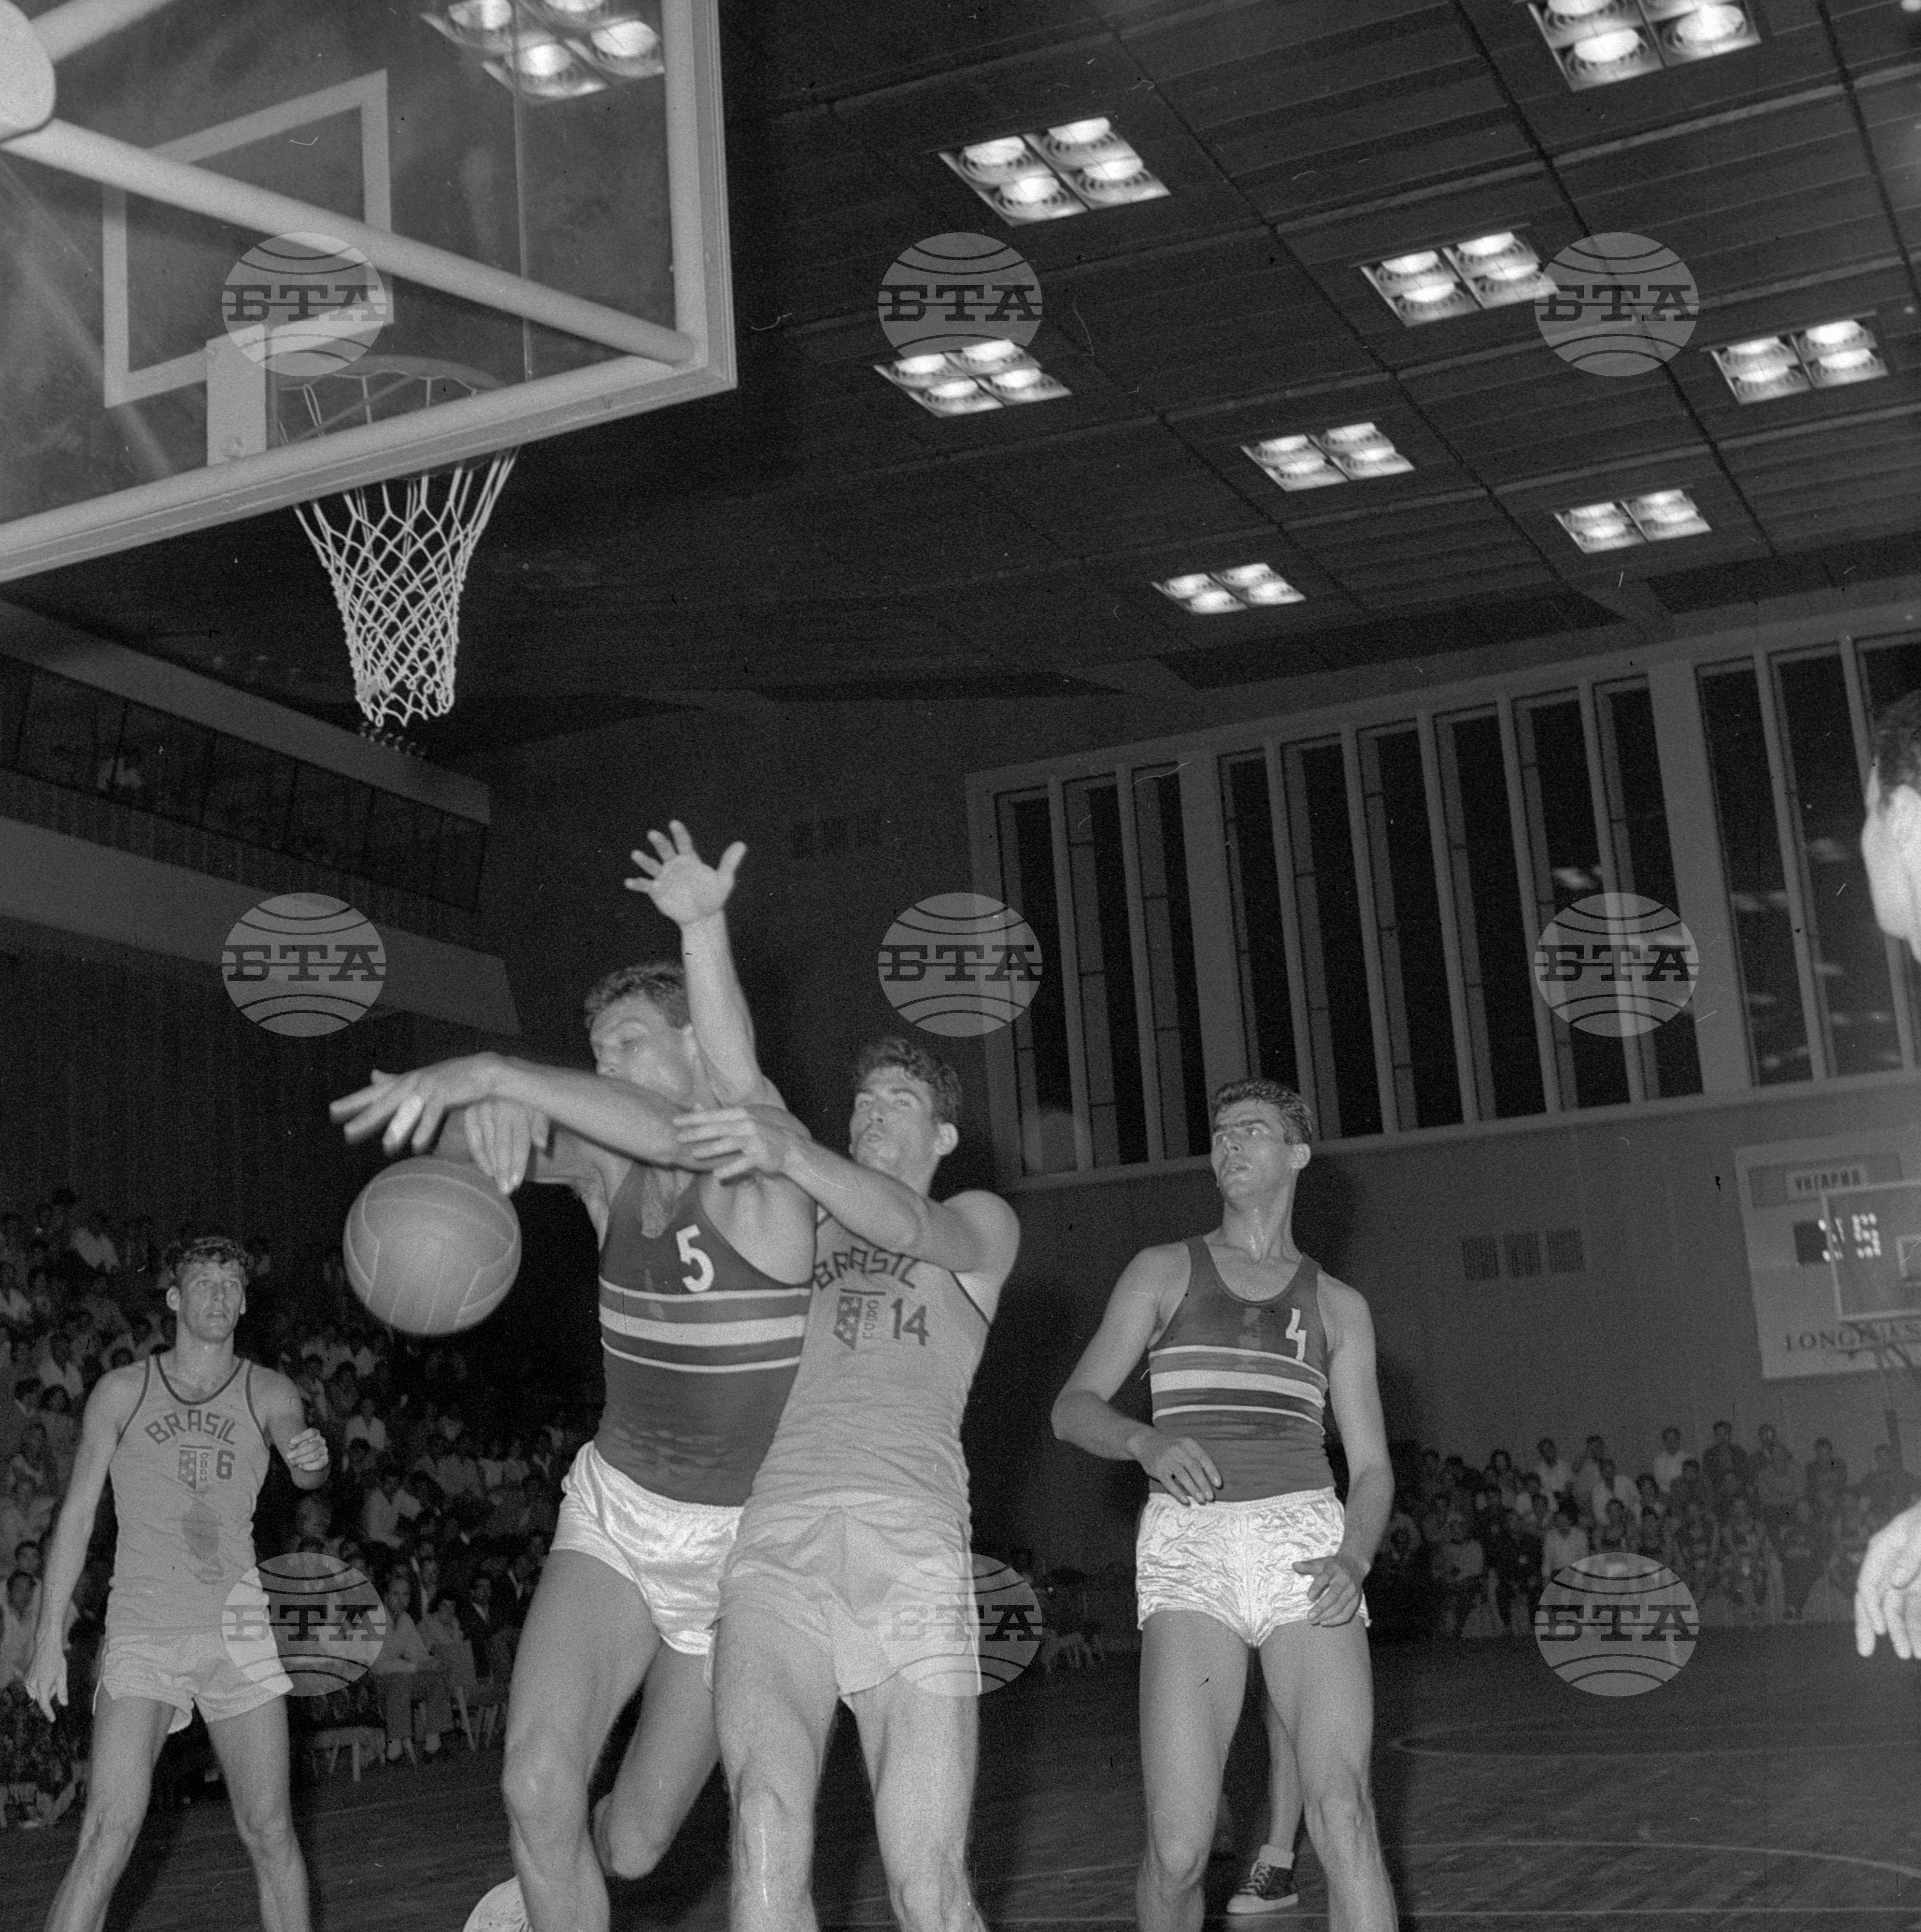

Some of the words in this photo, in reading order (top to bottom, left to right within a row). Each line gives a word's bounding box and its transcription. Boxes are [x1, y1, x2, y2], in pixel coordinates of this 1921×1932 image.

[676, 1224, 715, 1293] 5
[813, 1246, 919, 1290] BRASIL
[892, 1298, 930, 1346] 14
[1285, 1308, 1306, 1361] 4
[144, 1409, 236, 1445] BRASIL
[216, 1449, 236, 1480] 6
